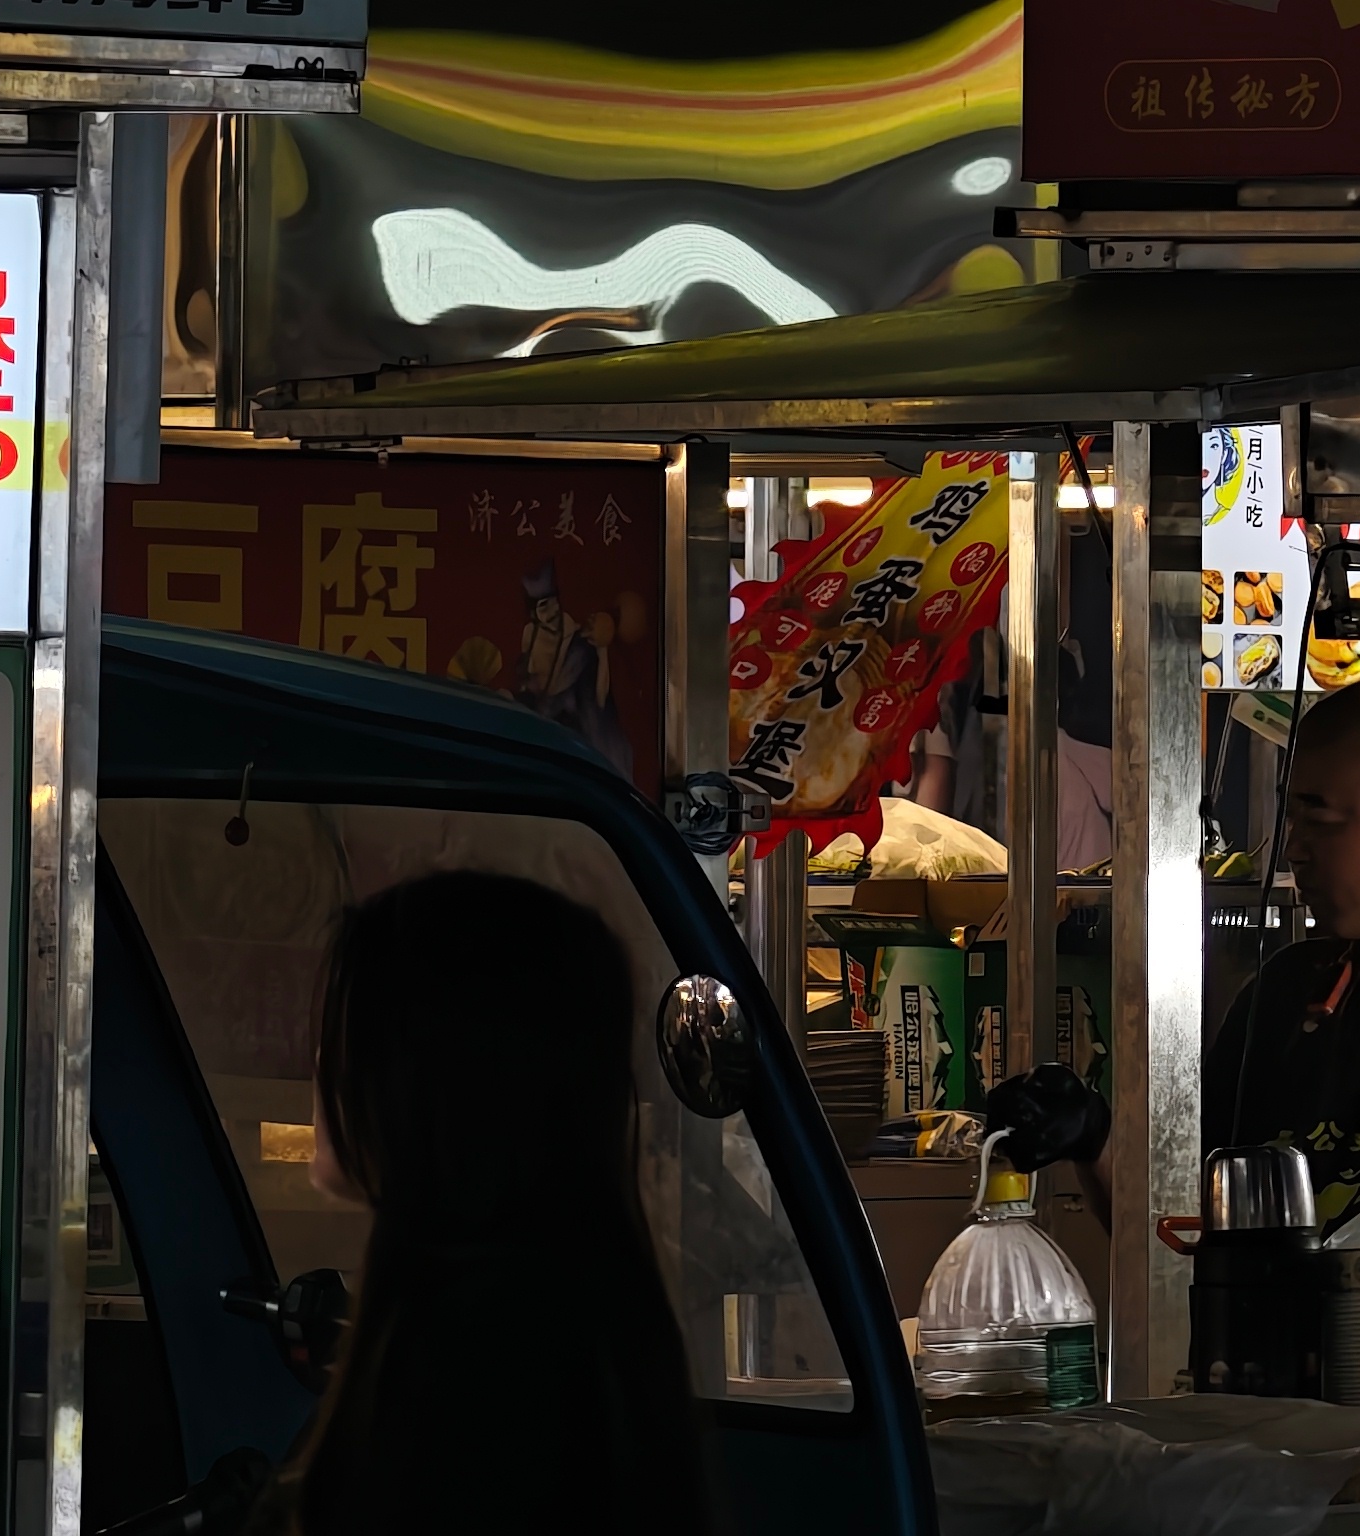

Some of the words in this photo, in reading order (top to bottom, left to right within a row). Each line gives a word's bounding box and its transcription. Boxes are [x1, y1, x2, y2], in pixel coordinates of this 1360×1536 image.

[468, 489, 632, 547] 济公美食
[132, 491, 438, 675] 豆腐
